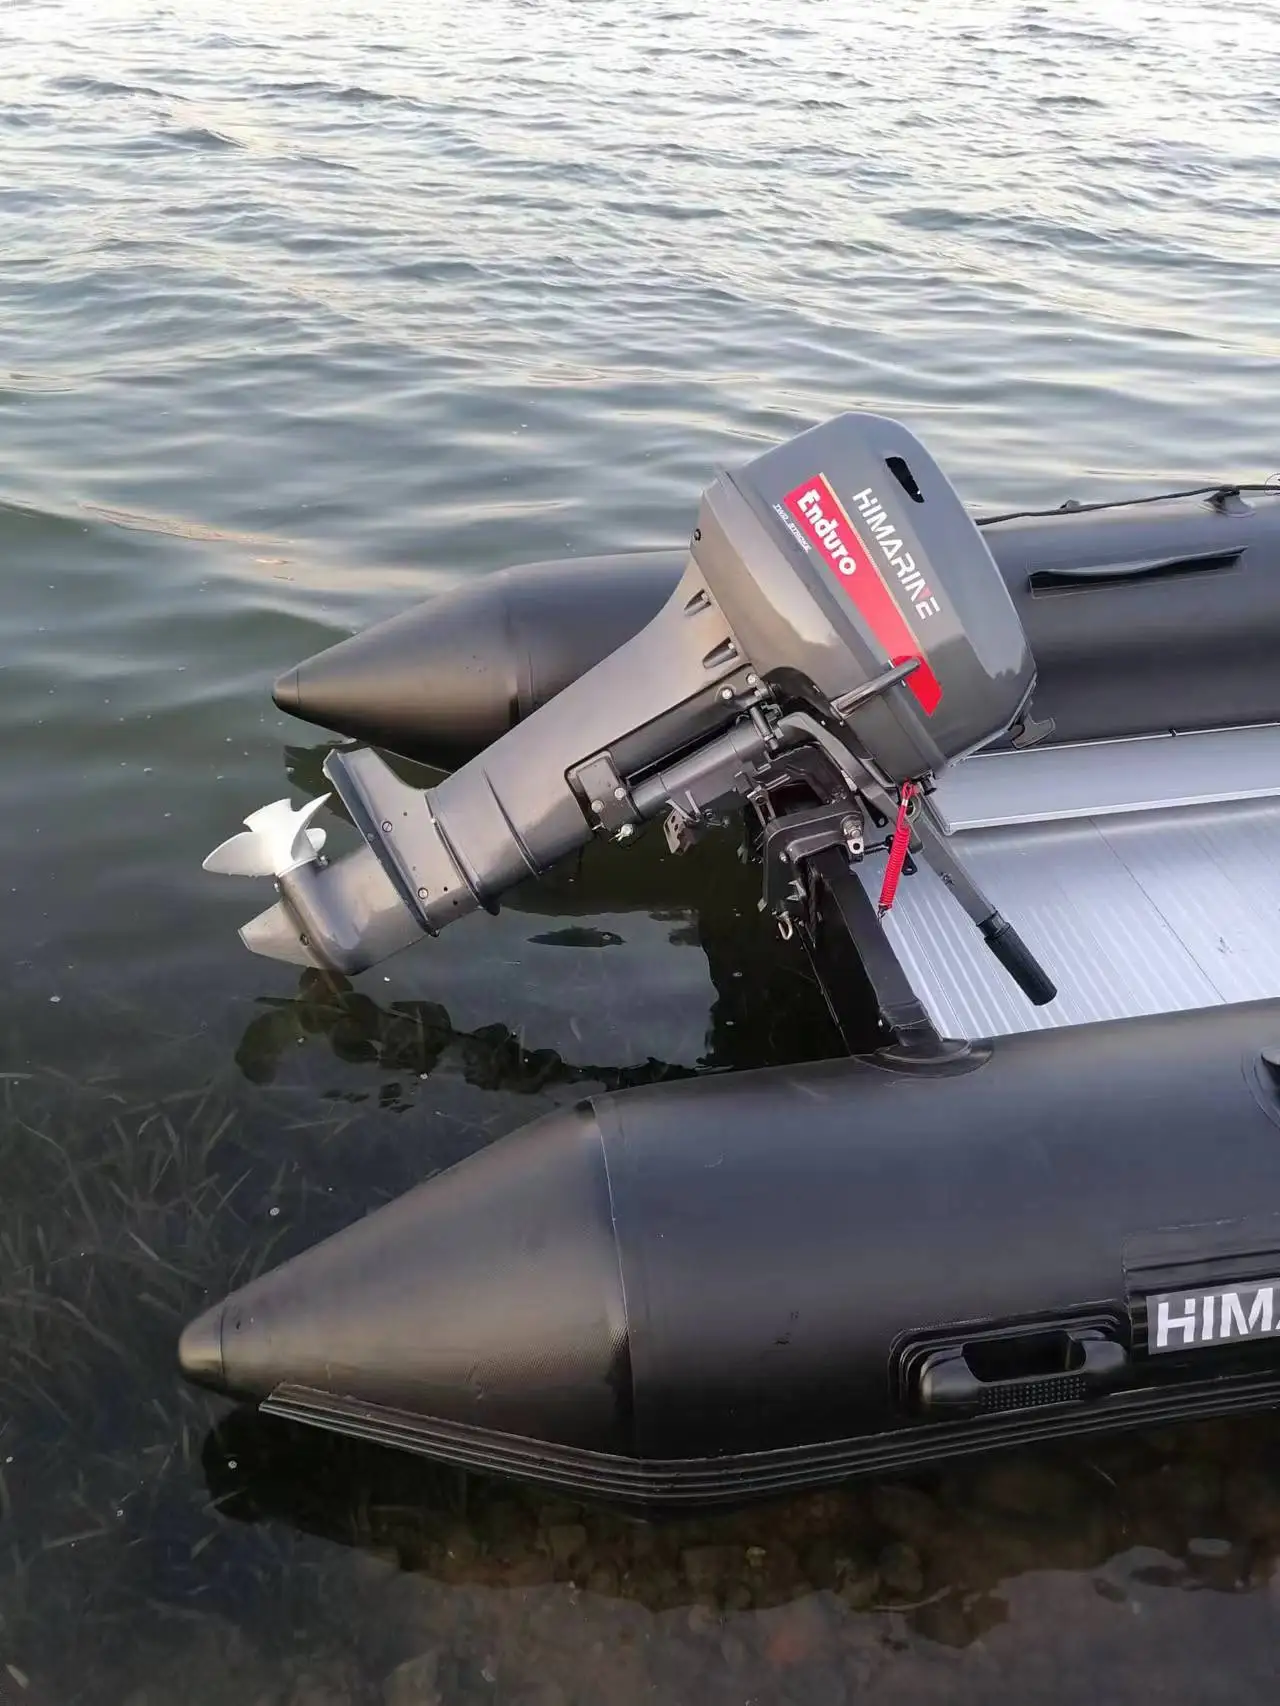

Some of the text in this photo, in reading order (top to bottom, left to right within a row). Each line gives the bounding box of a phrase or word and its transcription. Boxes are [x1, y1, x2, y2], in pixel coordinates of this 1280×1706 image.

[797, 489, 857, 576] Enduro
[852, 488, 941, 620] HIMARINE
[1156, 1287, 1280, 1348] HIM
